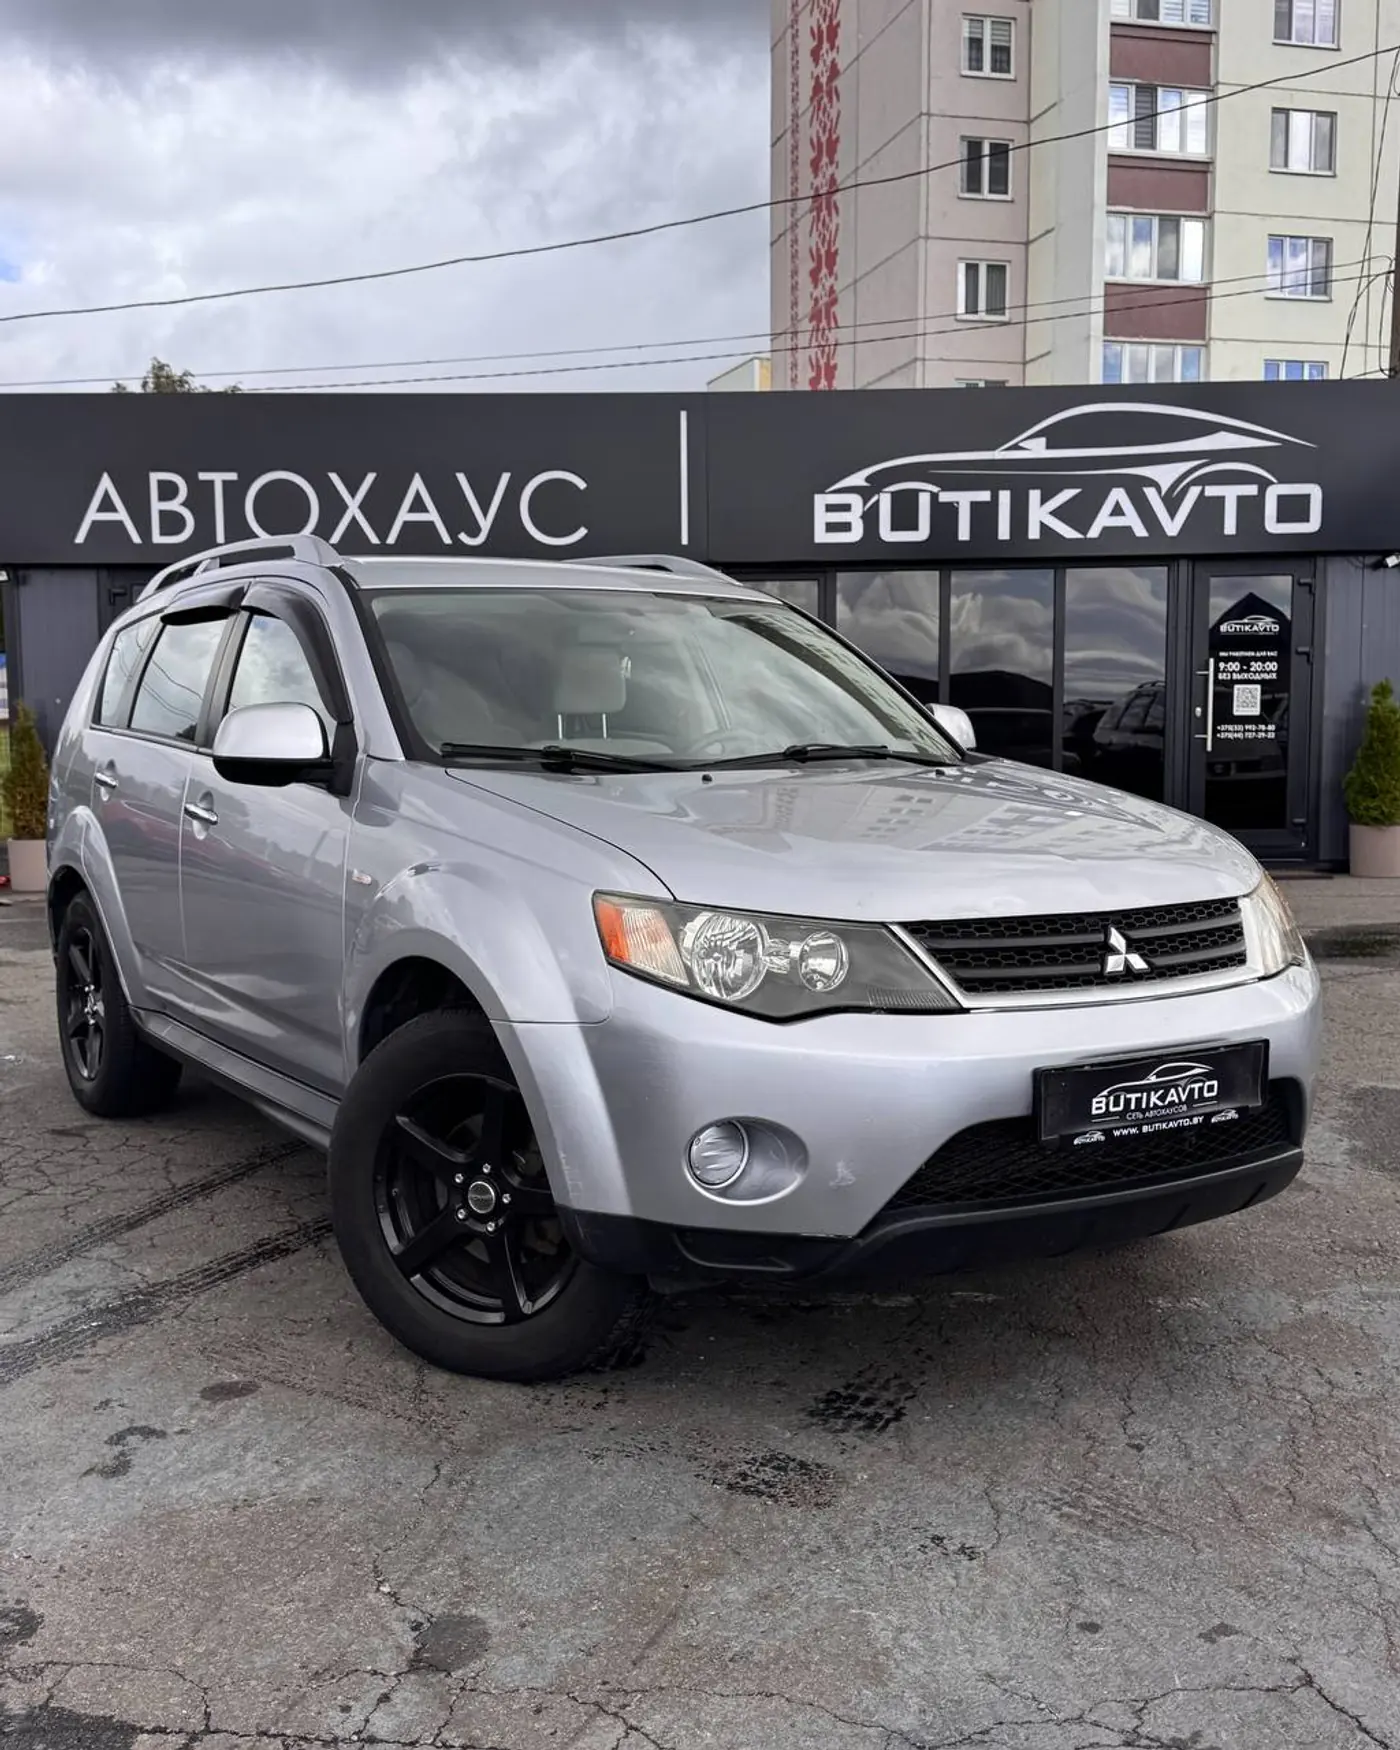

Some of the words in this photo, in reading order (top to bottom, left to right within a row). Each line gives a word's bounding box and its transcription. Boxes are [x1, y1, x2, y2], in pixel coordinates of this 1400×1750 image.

[74, 470, 589, 545] АВТОХАУС
[813, 482, 1323, 543] BUTIKAVTO
[1219, 624, 1280, 632] BUTIKAVTO
[1218, 661, 1240, 672] 9:00
[1249, 660, 1278, 671] 20:00
[1218, 672, 1231, 680] БЕЗ
[1232, 672, 1277, 680] ВЫХОДНЫХ
[1091, 1080, 1218, 1115] BUTIKAVTO
[1126, 1111, 1144, 1121] СЕТЬ
[1144, 1104, 1188, 1118] АВТОХАУСОВ
[1112, 1126, 1139, 1137] WWW.
[1142, 1115, 1205, 1133] BUTIKAVTO.BY
